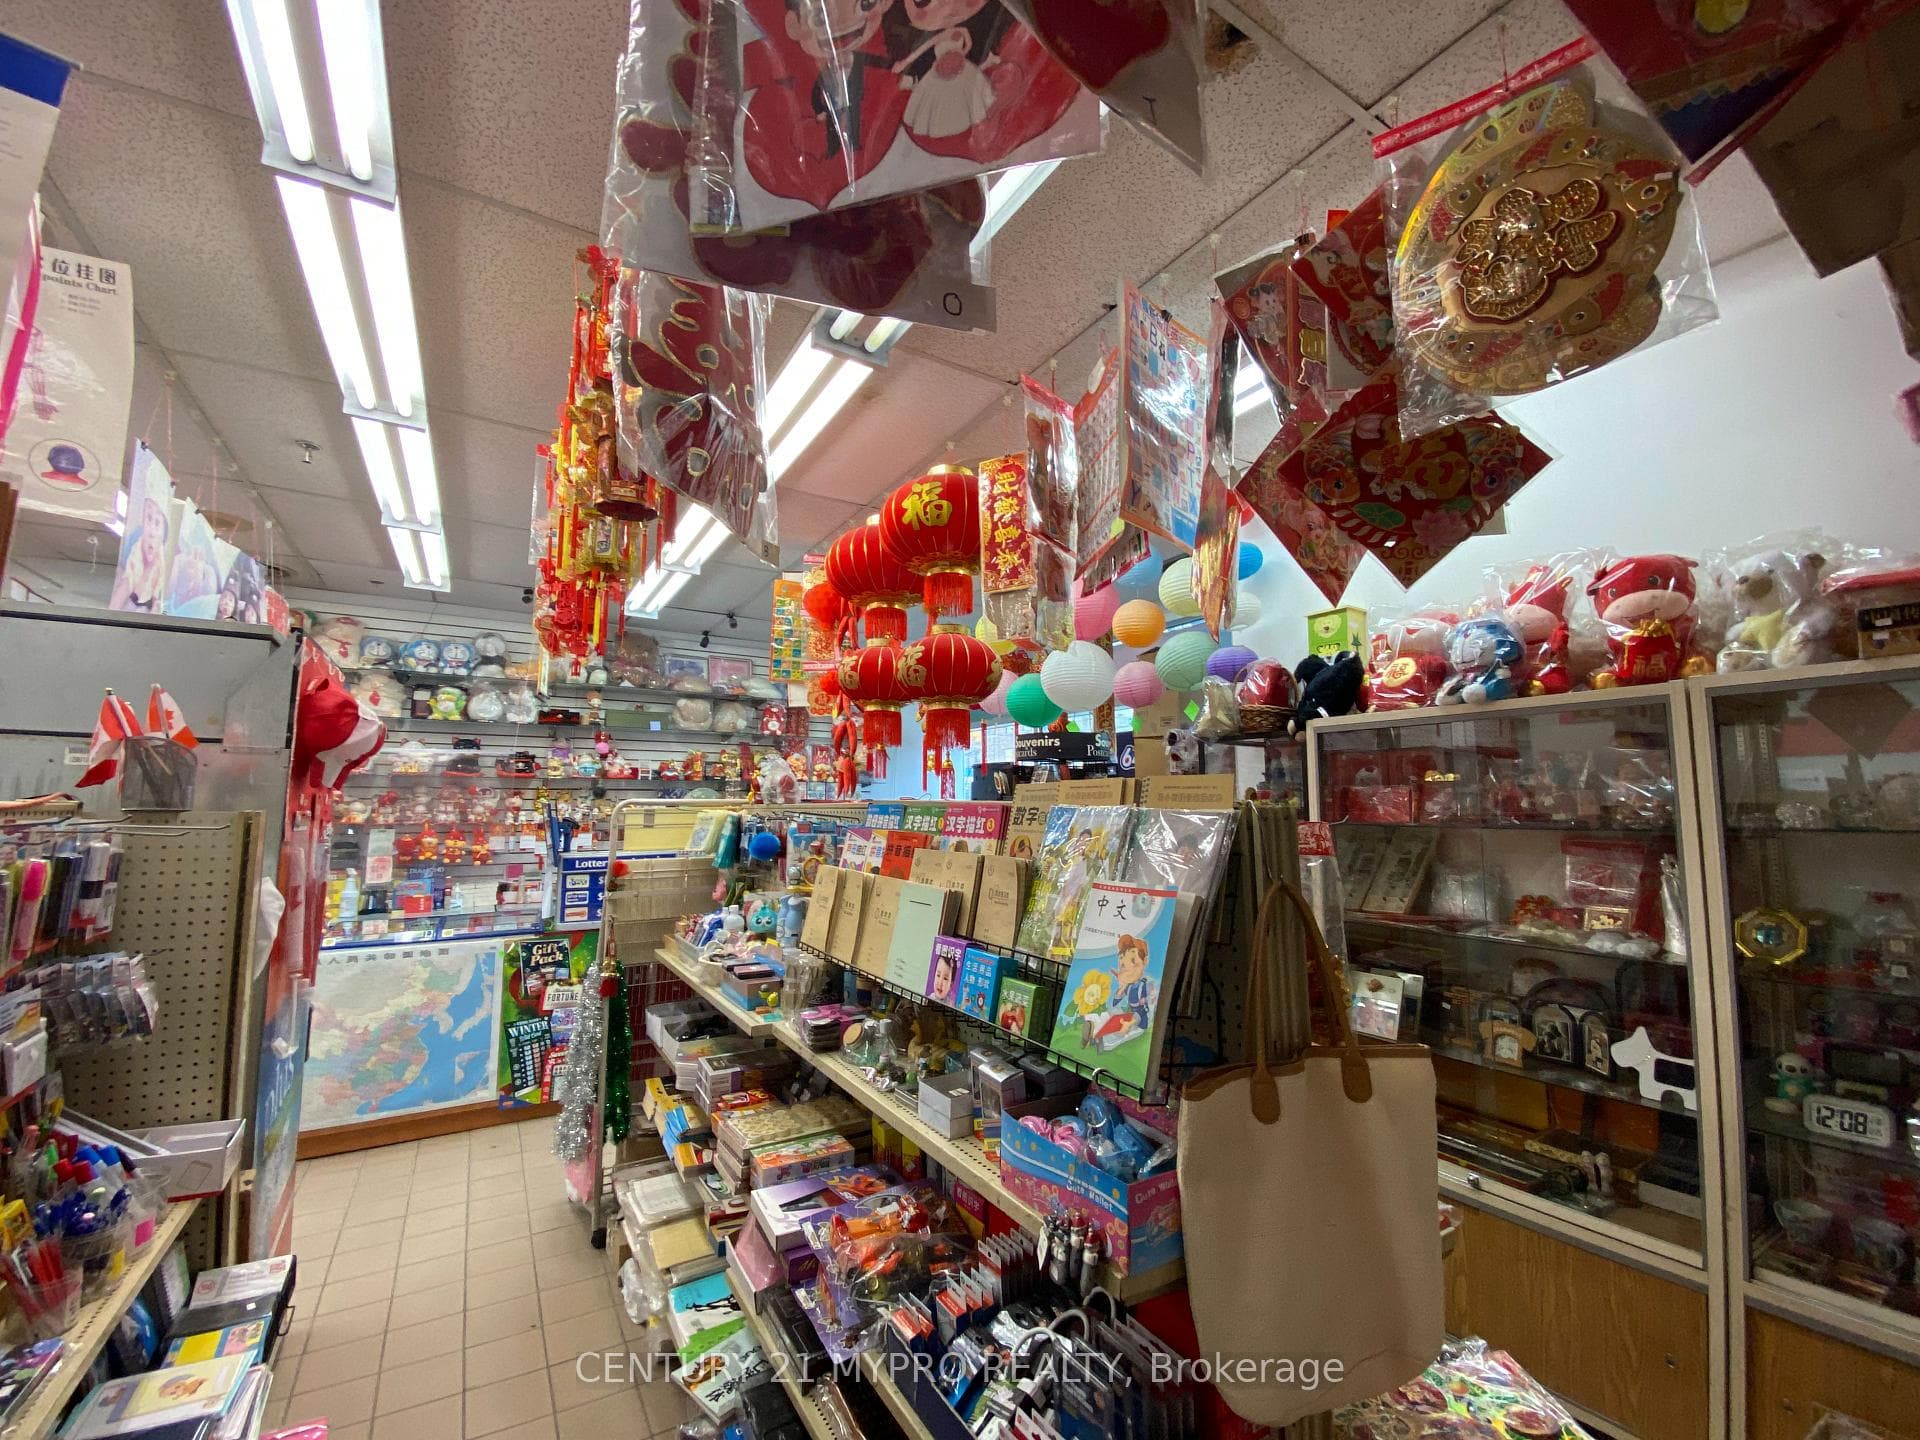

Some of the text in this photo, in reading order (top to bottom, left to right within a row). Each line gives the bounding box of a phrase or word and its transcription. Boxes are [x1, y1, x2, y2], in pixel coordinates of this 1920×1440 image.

[40, 255, 117, 285] 位挂图
[42, 273, 118, 295] points Chart
[901, 481, 952, 530] 福
[896, 645, 927, 688] 福
[945, 815, 986, 834] 汉字描红
[1012, 806, 1039, 826] 数字
[575, 860, 608, 868] Lotter
[1097, 895, 1127, 920] 中文
[530, 952, 563, 966] Pack
[532, 943, 559, 955] Gift
[547, 992, 579, 1001] FORTUNE
[508, 1020, 549, 1038] WINTER
[1066, 1179, 1113, 1212] Cute Wallet
